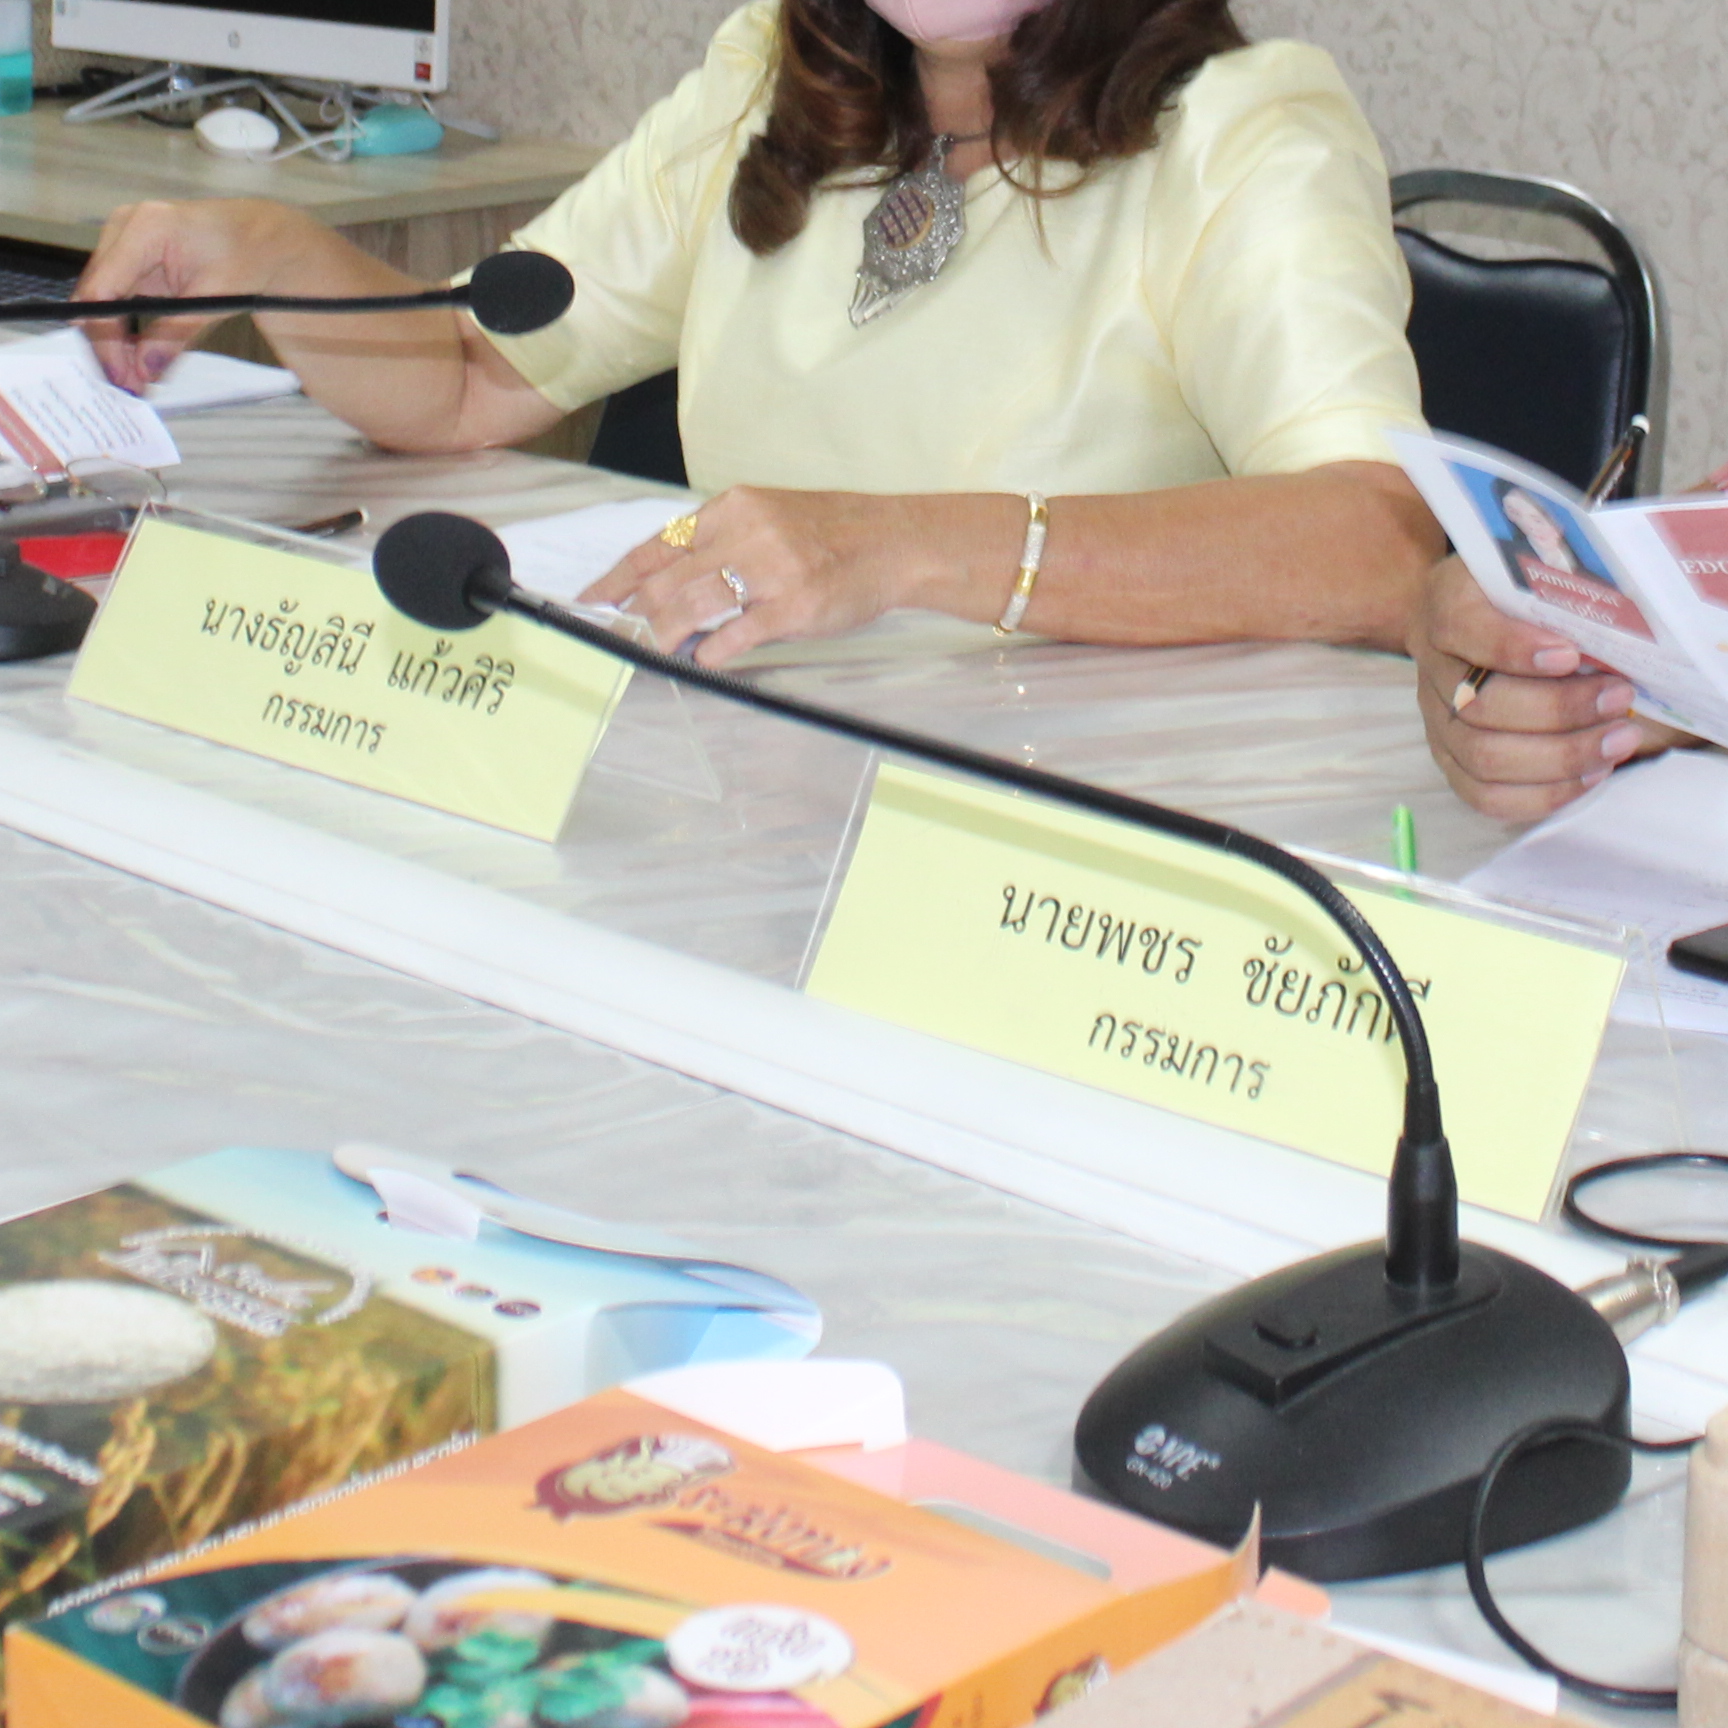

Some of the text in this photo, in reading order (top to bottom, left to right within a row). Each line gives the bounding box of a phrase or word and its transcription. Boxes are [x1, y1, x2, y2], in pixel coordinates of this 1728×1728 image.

[200, 597, 516, 717] นางธัญสินี แก้วศิริ
[261, 691, 387, 754] กรรมการ
[999, 883, 1202, 984] นายพชร
[1088, 1010, 1270, 1101] กรรมการ
